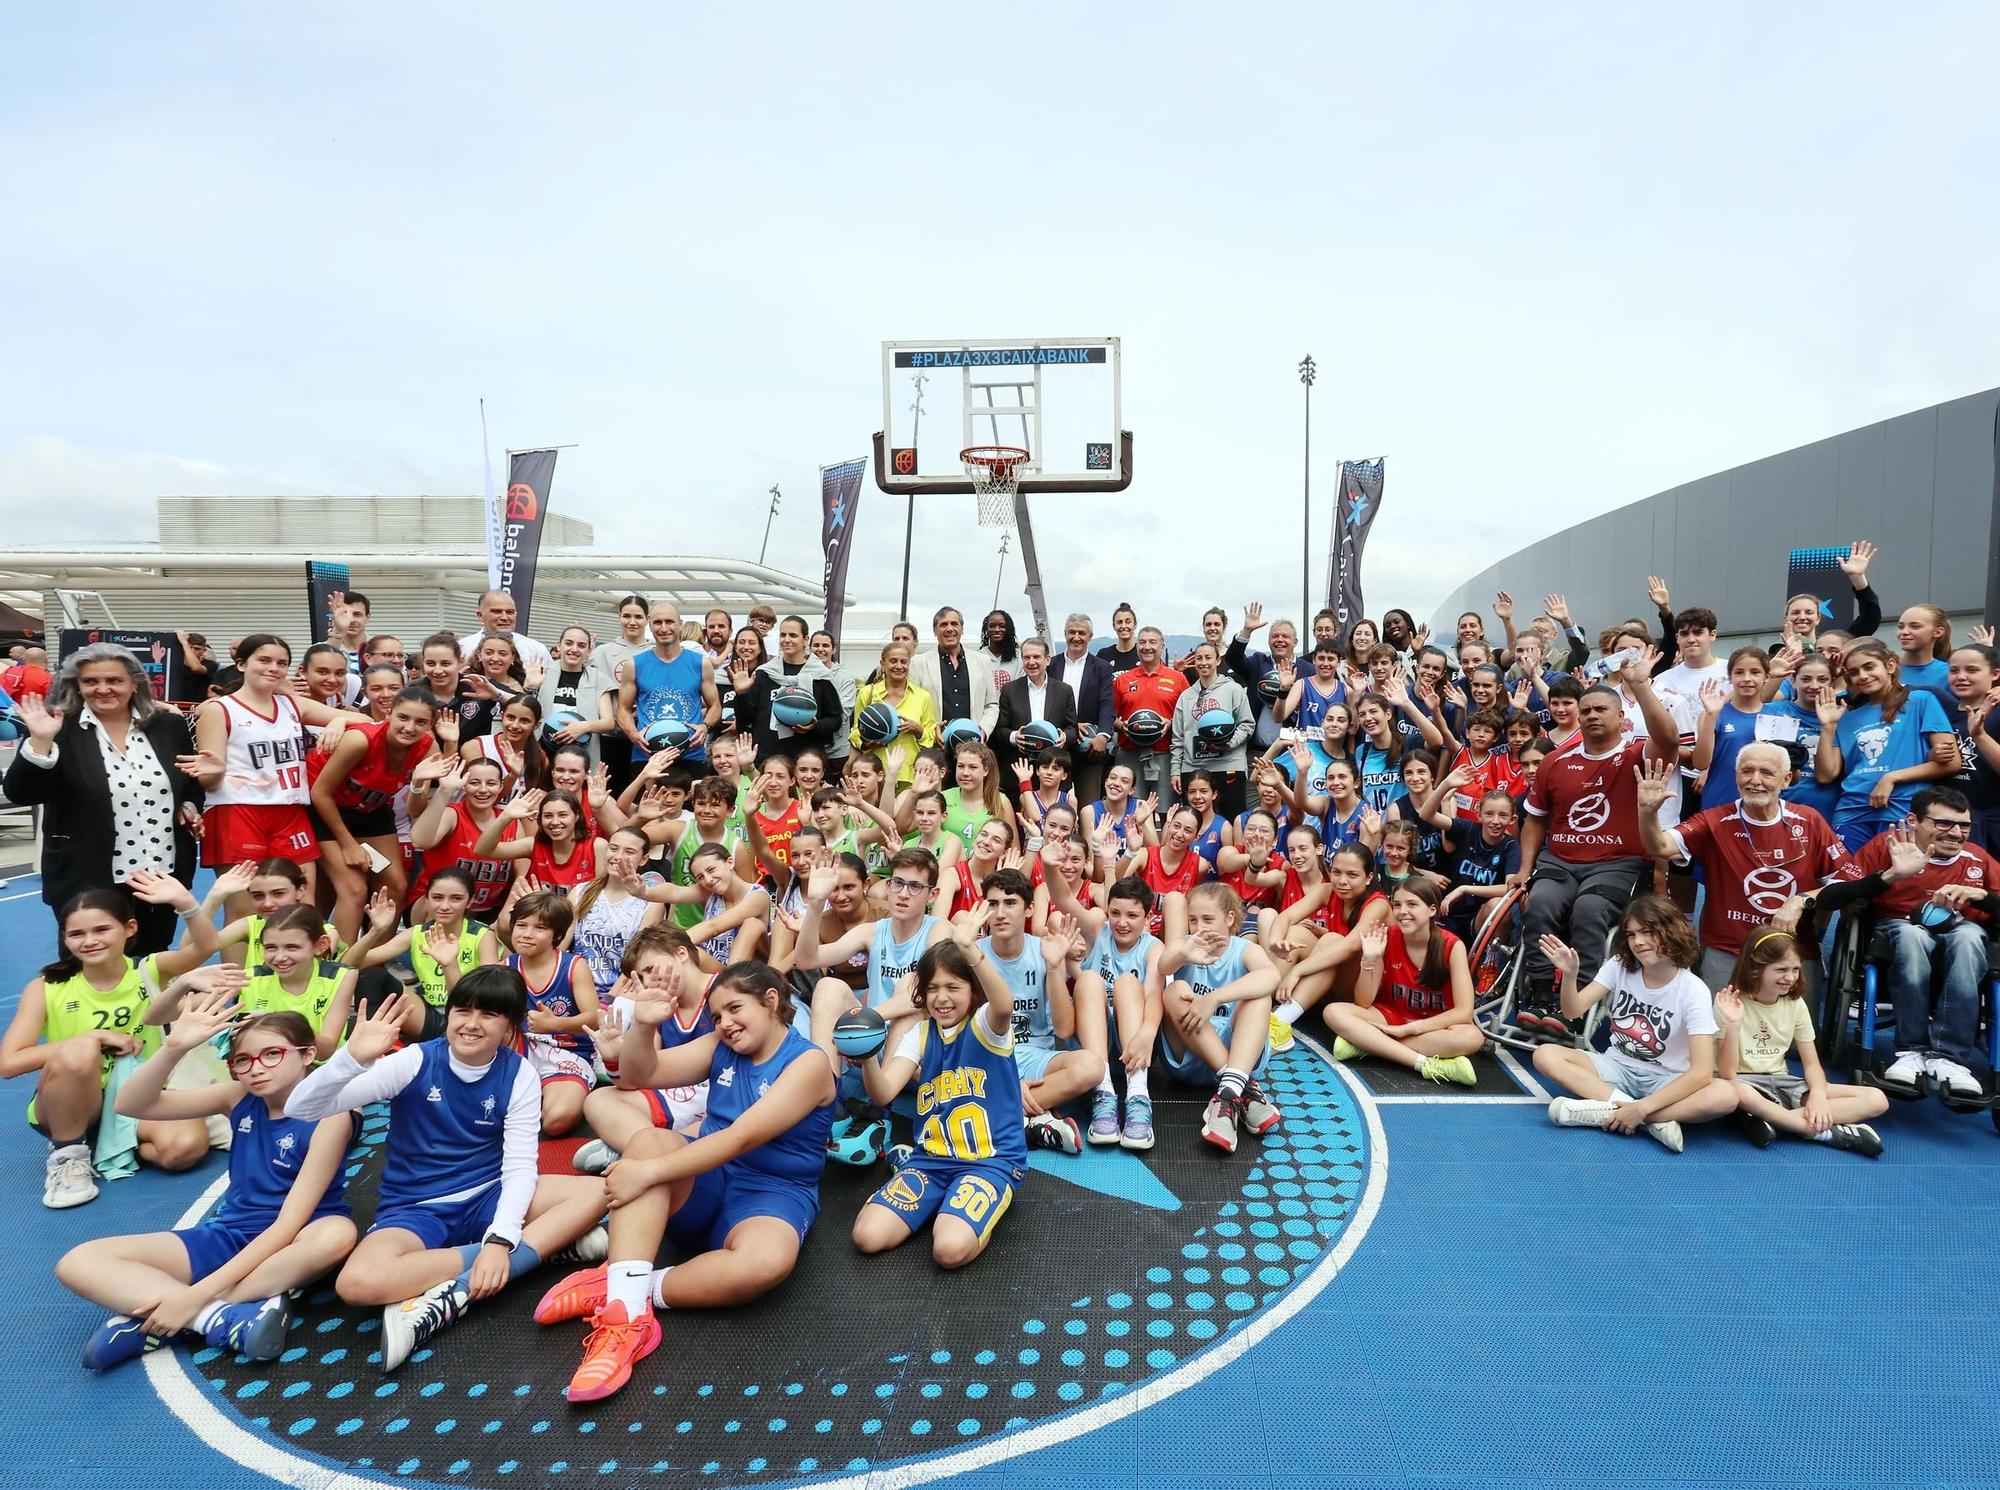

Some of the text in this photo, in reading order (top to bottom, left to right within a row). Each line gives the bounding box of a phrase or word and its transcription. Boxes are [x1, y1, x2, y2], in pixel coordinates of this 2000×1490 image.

[911, 349, 1089, 367] #PLAZA3X3CAIXABANK
[276, 766, 300, 790] 10
[1373, 789, 1388, 812] 10
[289, 831, 311, 850] 10
[962, 823, 974, 839] 4
[776, 849, 787, 864] 9
[1727, 910, 1771, 925] IBERC
[1025, 971, 1036, 986] 11
[1013, 999, 1038, 1011] ORES
[92, 1006, 131, 1030] 28
[1612, 990, 1673, 1041] PIXIES
[881, 1190, 919, 1212] WARRIORS
[950, 1183, 990, 1222] 30
